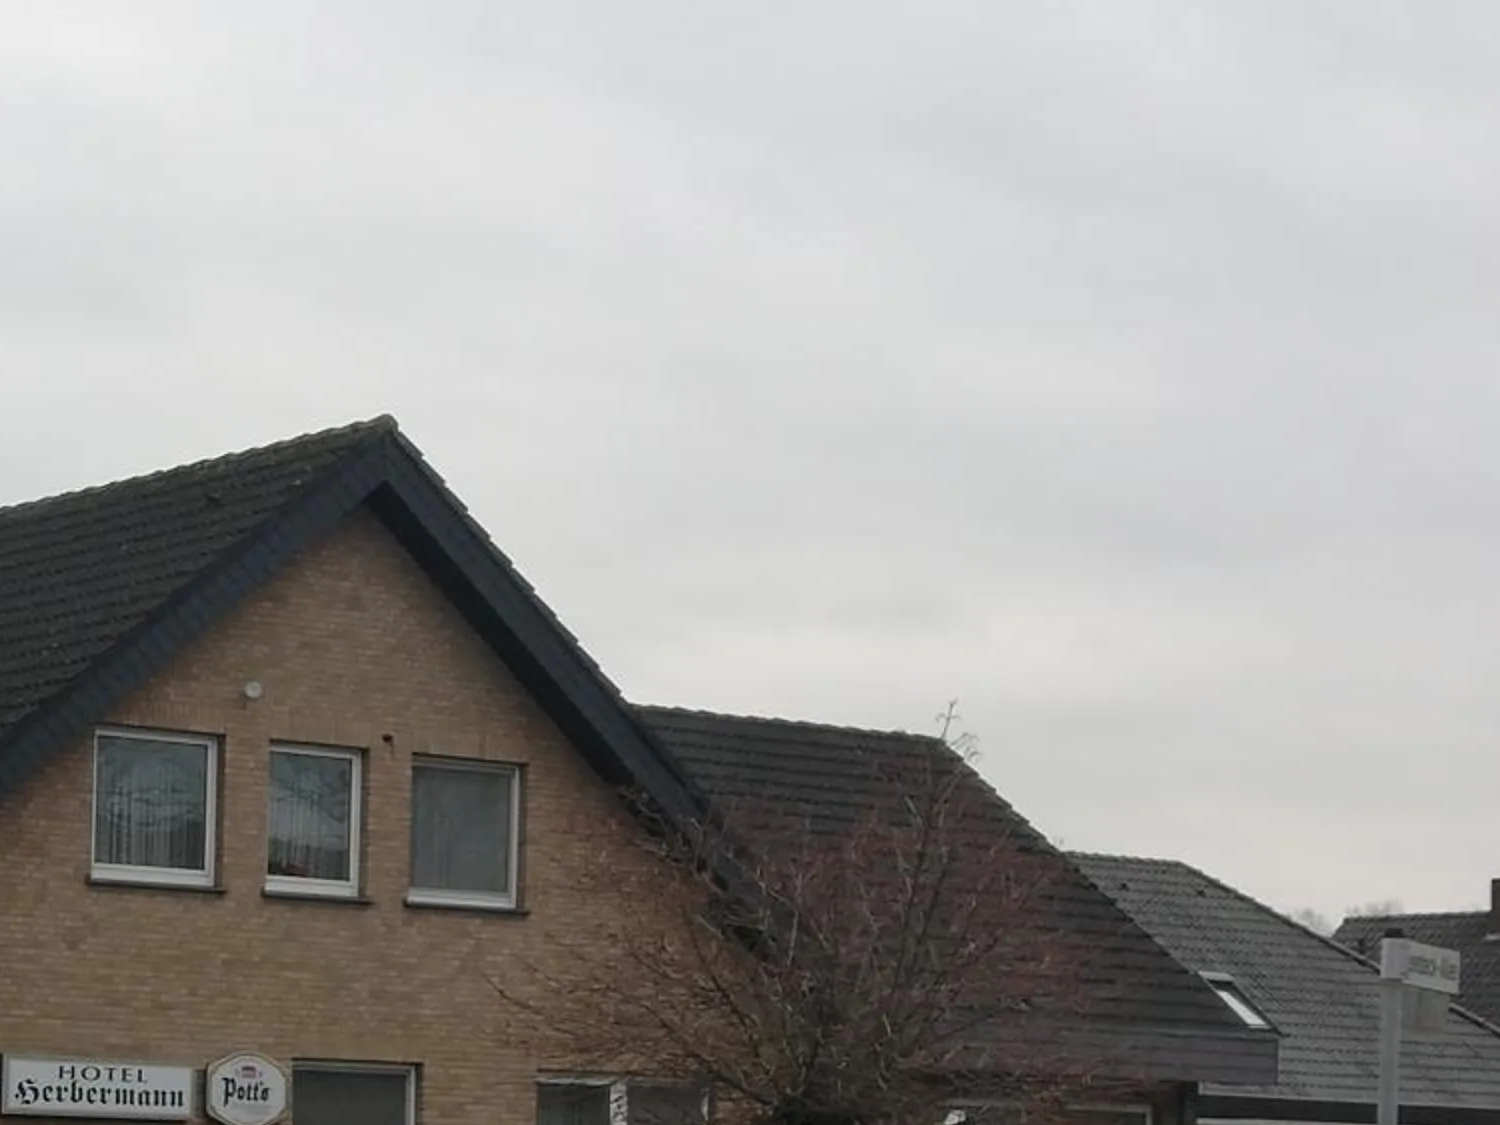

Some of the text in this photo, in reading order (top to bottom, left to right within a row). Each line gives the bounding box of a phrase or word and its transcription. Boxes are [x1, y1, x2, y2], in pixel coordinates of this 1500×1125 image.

[58, 1065, 149, 1083] HOTEL
[15, 1078, 185, 1107] Herbermann
[221, 1077, 270, 1108] Pott's
